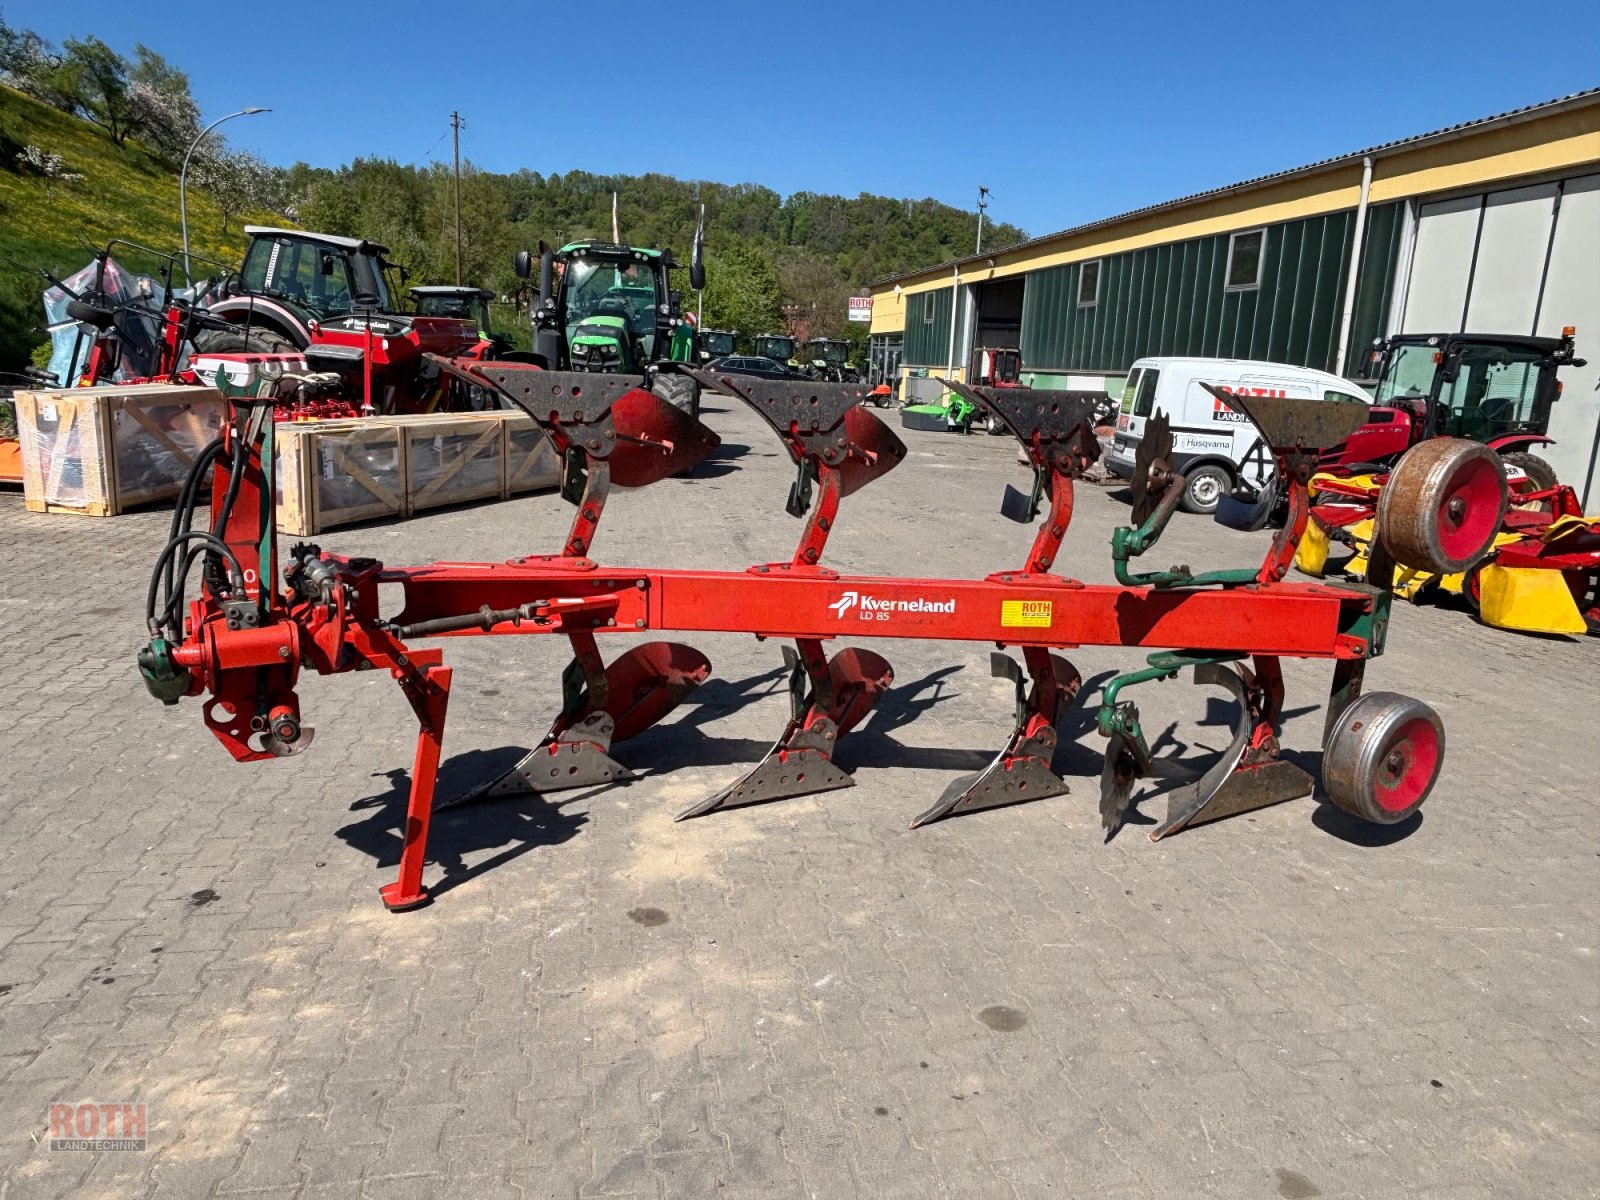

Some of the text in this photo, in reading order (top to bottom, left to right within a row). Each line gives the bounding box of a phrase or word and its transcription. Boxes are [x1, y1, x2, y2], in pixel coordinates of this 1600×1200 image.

[850, 298, 871, 307] ROTH
[1187, 438, 1230, 449] Husqvarna
[861, 596, 956, 613] Kverneland
[1022, 602, 1050, 613] ROTH
[859, 611, 890, 621] LD 85
